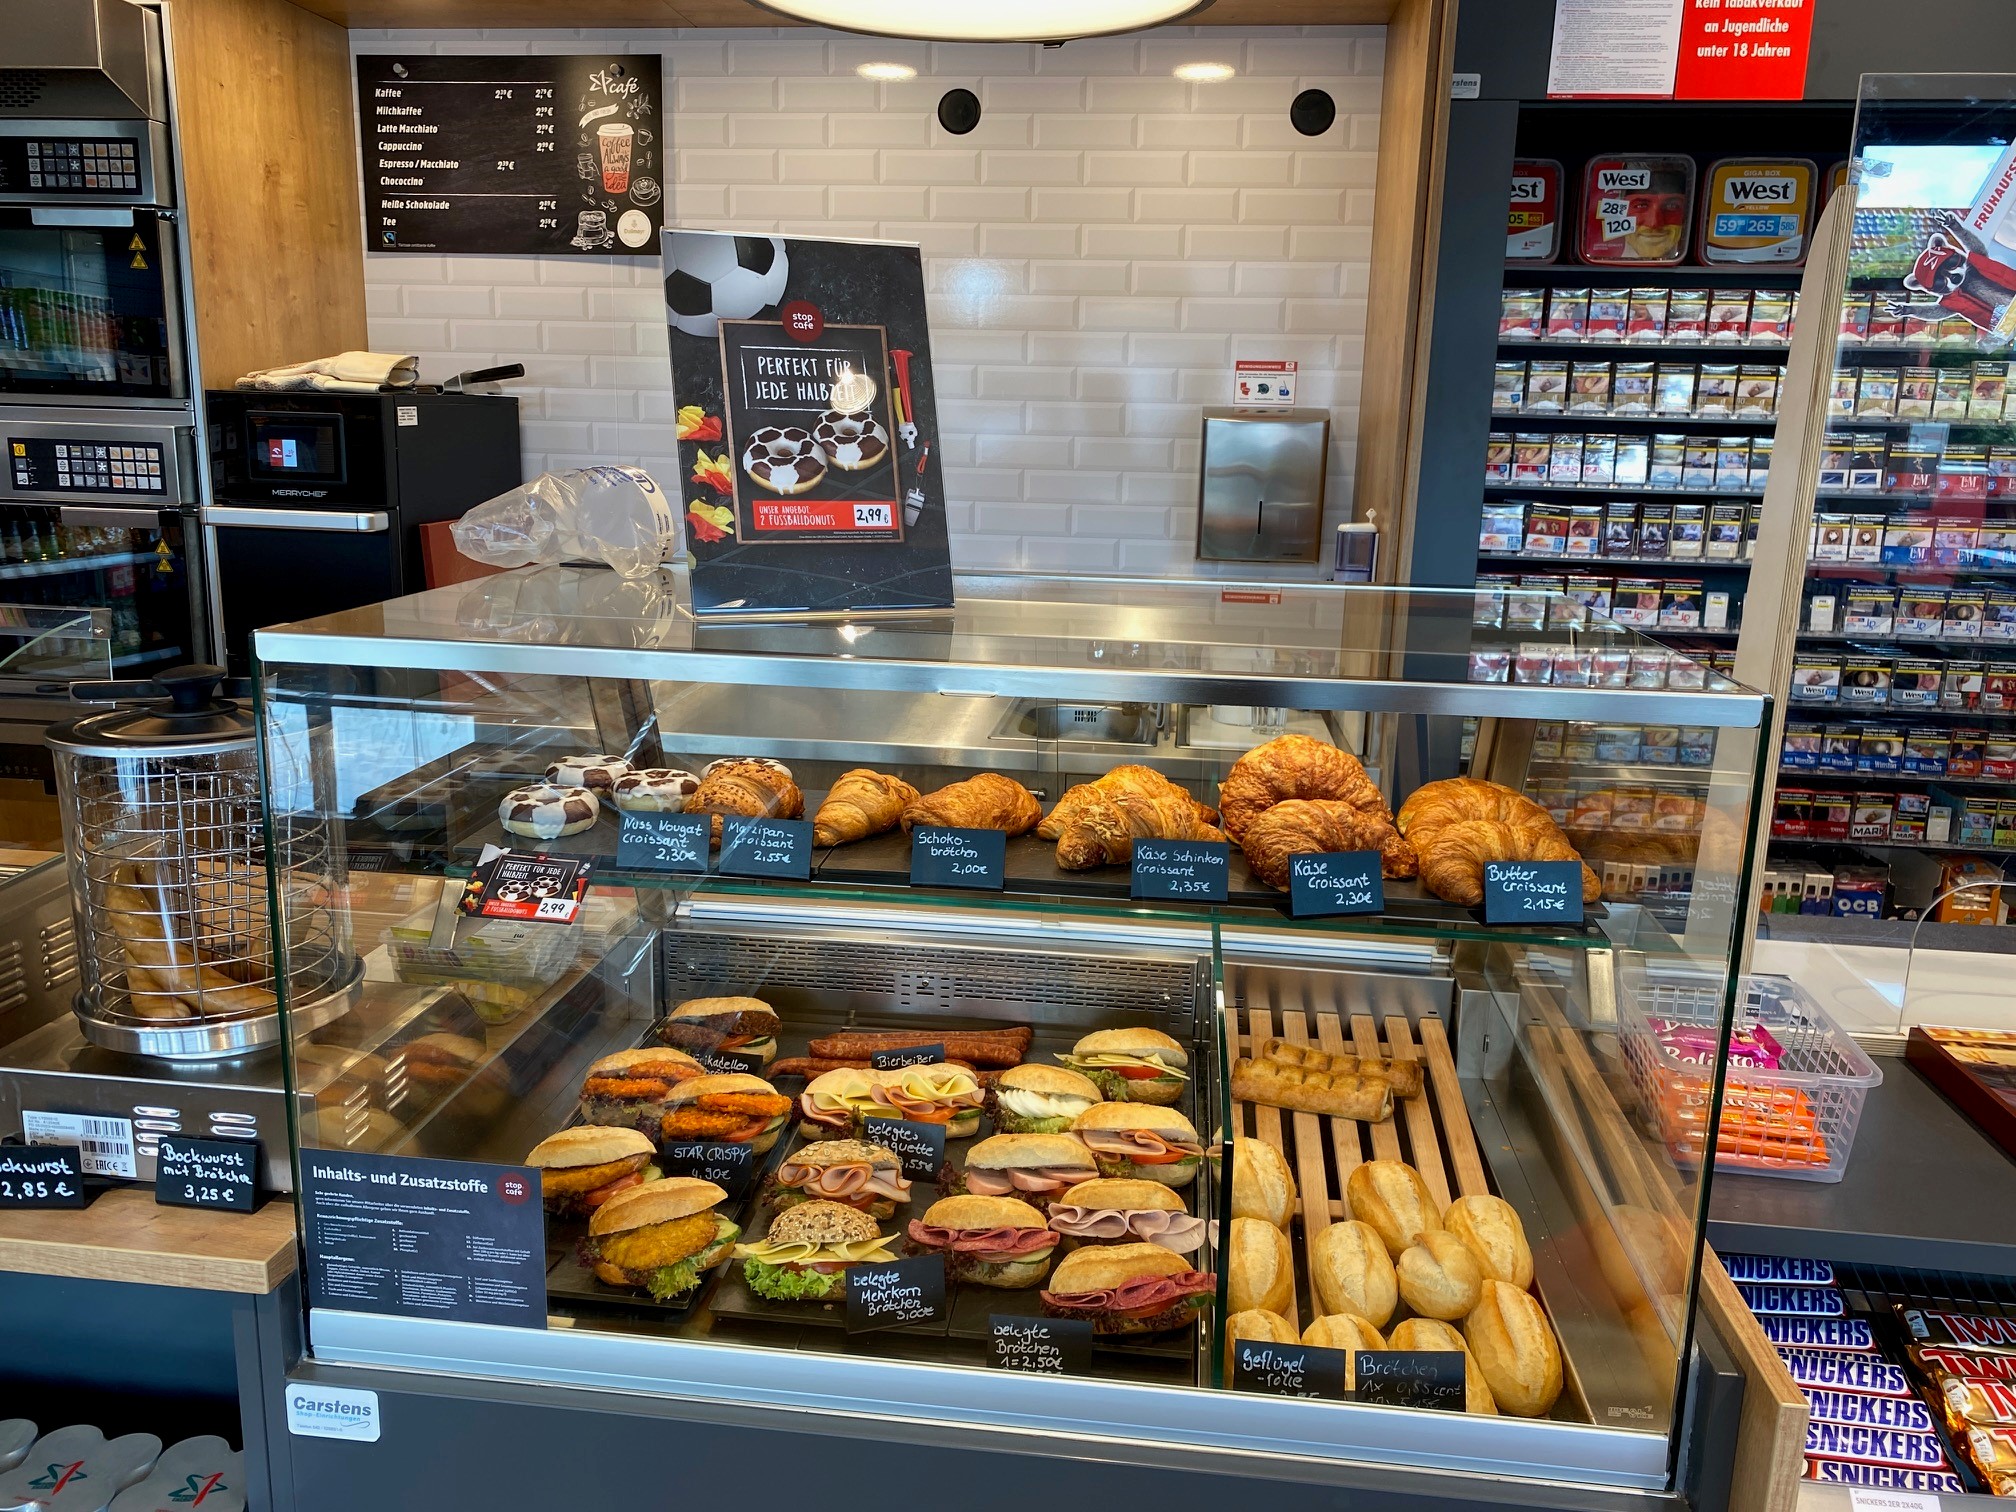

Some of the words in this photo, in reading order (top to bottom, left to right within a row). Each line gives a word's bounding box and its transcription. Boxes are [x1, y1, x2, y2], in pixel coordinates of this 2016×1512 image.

[1704, 21, 1719, 33] an
[1721, 18, 1790, 37] Jugendliche
[1696, 44, 1730, 58] unter
[1733, 43, 1748, 58] 18
[1750, 43, 1791, 58] Jahren
[609, 77, 640, 99] café
[377, 124, 398, 133] Latte
[601, 137, 631, 155] Coffee
[379, 158, 414, 169] Espresso
[414, 159, 420, 168] /
[603, 148, 630, 165] Always
[605, 179, 627, 191] idea
[1602, 172, 1646, 187] West
[1730, 181, 1790, 200] West
[381, 199, 404, 209] Heiße
[405, 200, 451, 210] Schokolade
[382, 216, 397, 226] Tee
[792, 312, 814, 321] stop
[793, 321, 814, 330] cafe
[757, 356, 818, 377] PERFEKT
[825, 357, 851, 378] FÜR
[755, 381, 789, 400] JEDE
[796, 382, 856, 402] HALBZEIT
[272, 489, 328, 498] MERRYCHEF
[759, 505, 779, 514] UNSER
[856, 508, 882, 524] 2,99
[883, 513, 889, 524] €
[760, 515, 766, 525] 2
[769, 514, 836, 526] FUSSBALLDONUTS
[1805, 687, 1825, 695] West
[1854, 688, 1874, 696] West
[1904, 691, 1925, 699] West
[1794, 756, 1816, 765] Winston
[1831, 758, 1853, 767] Winston
[1874, 760, 1897, 769] Winston
[1919, 763, 1942, 772] Winston
[623, 817, 652, 832] Nuss
[658, 819, 703, 837] Nougat
[930, 845, 978, 859] brötchen
[1136, 845, 1168, 861] Käse
[1173, 848, 1224, 865] Schinken
[501, 870, 528, 880] HALBZEIT
[505, 863, 531, 872] PERFEKT
[532, 865, 545, 874] FÜR
[546, 867, 562, 875] JEDE
[950, 862, 989, 876] 2,00€
[1294, 860, 1328, 877] Käse
[1488, 864, 1539, 882] Butter
[1169, 879, 1211, 894] 2,35€
[1335, 892, 1373, 906] 2,30€
[1837, 898, 1879, 913] OCB
[540, 902, 565, 914] 2,99
[160, 1143, 245, 1168] Bockwurst
[673, 1148, 703, 1161] STAR
[706, 1147, 752, 1164] CRISPY
[0, 1158, 74, 1176] ckwurst
[163, 1165, 190, 1177] mit
[312, 1165, 367, 1183] Inhalts-
[370, 1171, 397, 1185] und
[399, 1173, 489, 1194] Zusatzstoffe
[505, 1181, 523, 1191] stop
[1, 1181, 48, 1200] 2,85
[54, 1182, 75, 1198] €
[184, 1184, 219, 1202] 3,25
[222, 1188, 235, 1201] €
[505, 1187, 523, 1196] cafe
[853, 1270, 901, 1290] belegte
[868, 1297, 921, 1317] Brötchen
[1760, 1316, 1870, 1346] NICKERS
[995, 1339, 1060, 1356] Brötchen
[293, 1396, 372, 1417] Carstens
[1805, 1421, 1942, 1464] SNICKERS
[1820, 1461, 1965, 1493] SNICKERS
[1855, 1497, 1888, 1507] SNICKERS
[1887, 1500, 1901, 1508] 2ER
[1901, 1502, 1924, 1510] 2X40G
